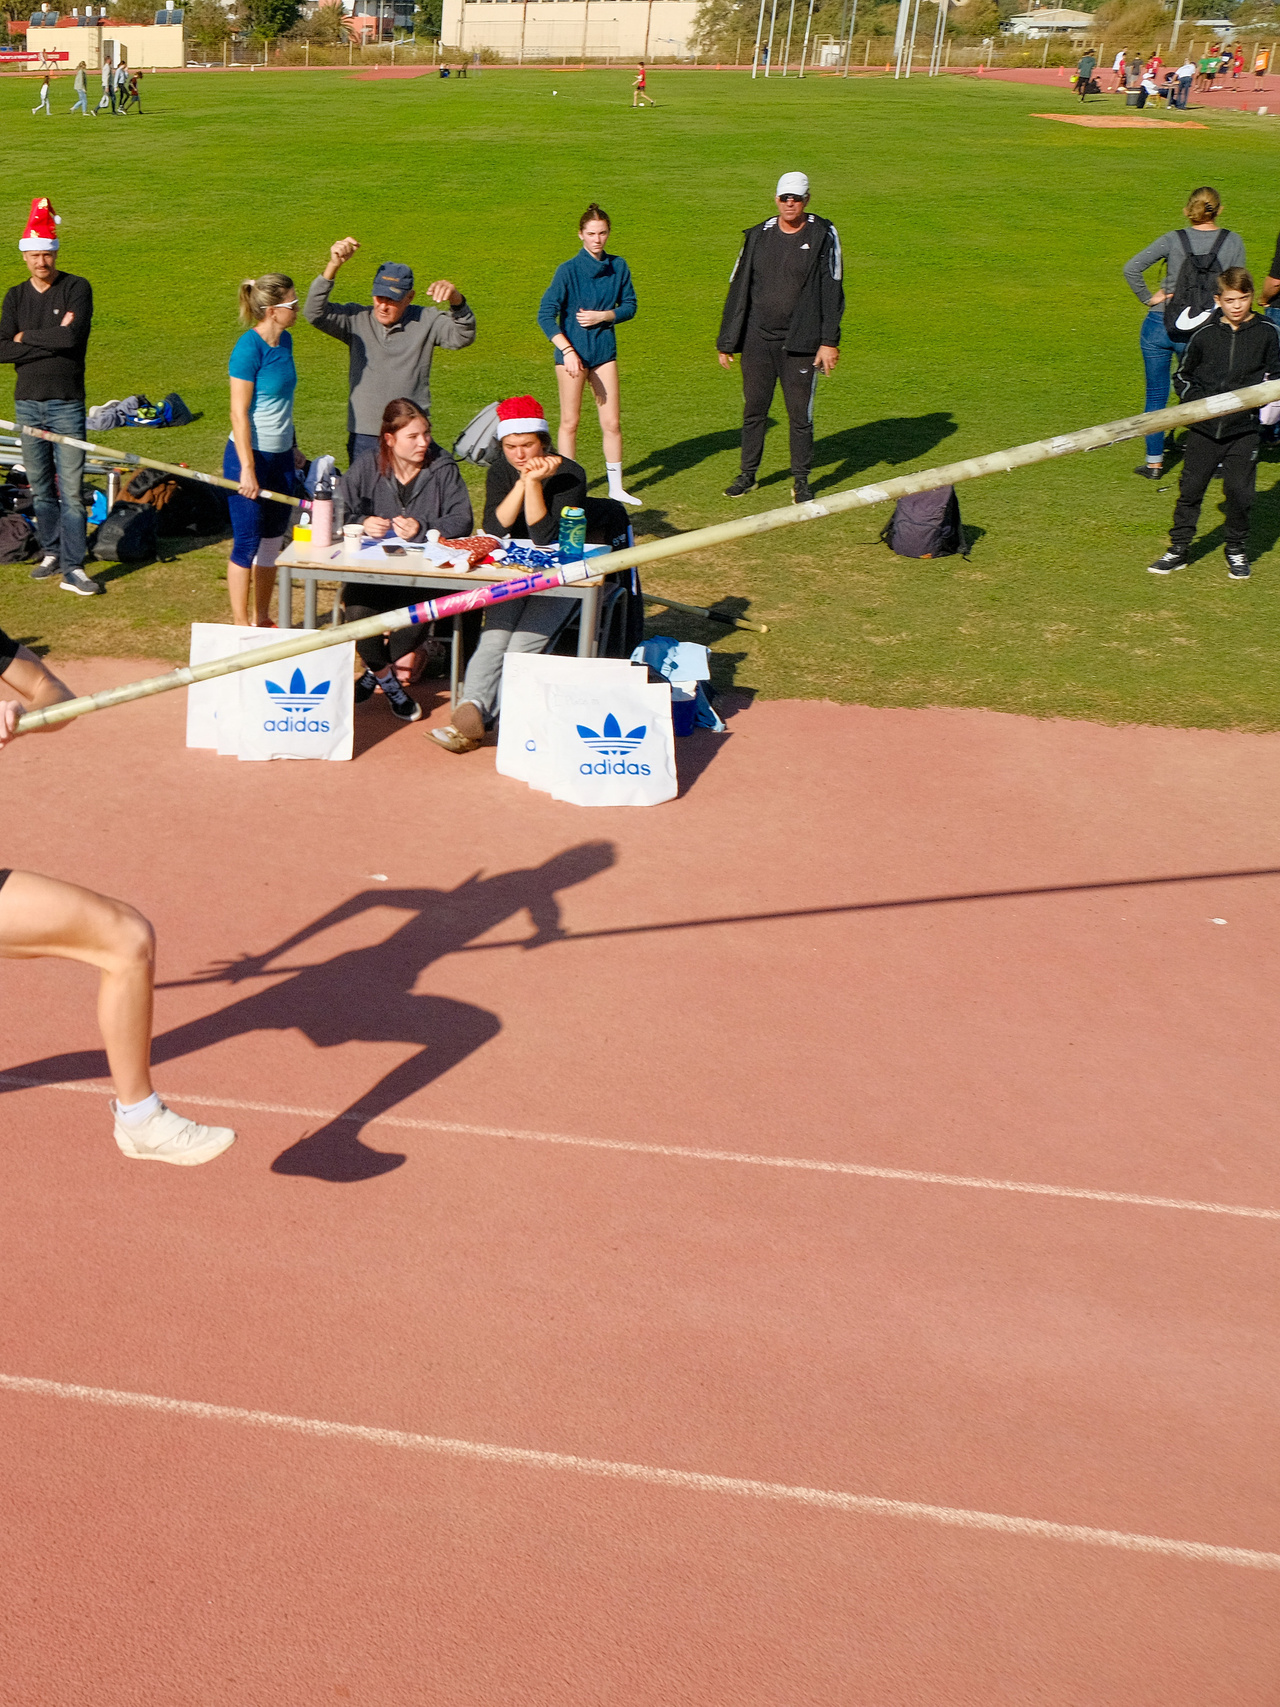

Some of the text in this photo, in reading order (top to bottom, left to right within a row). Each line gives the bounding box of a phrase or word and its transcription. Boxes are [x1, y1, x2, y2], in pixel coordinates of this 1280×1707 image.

[441, 587, 490, 612] Spirit
[263, 716, 331, 733] adidas
[579, 759, 652, 776] adidas
